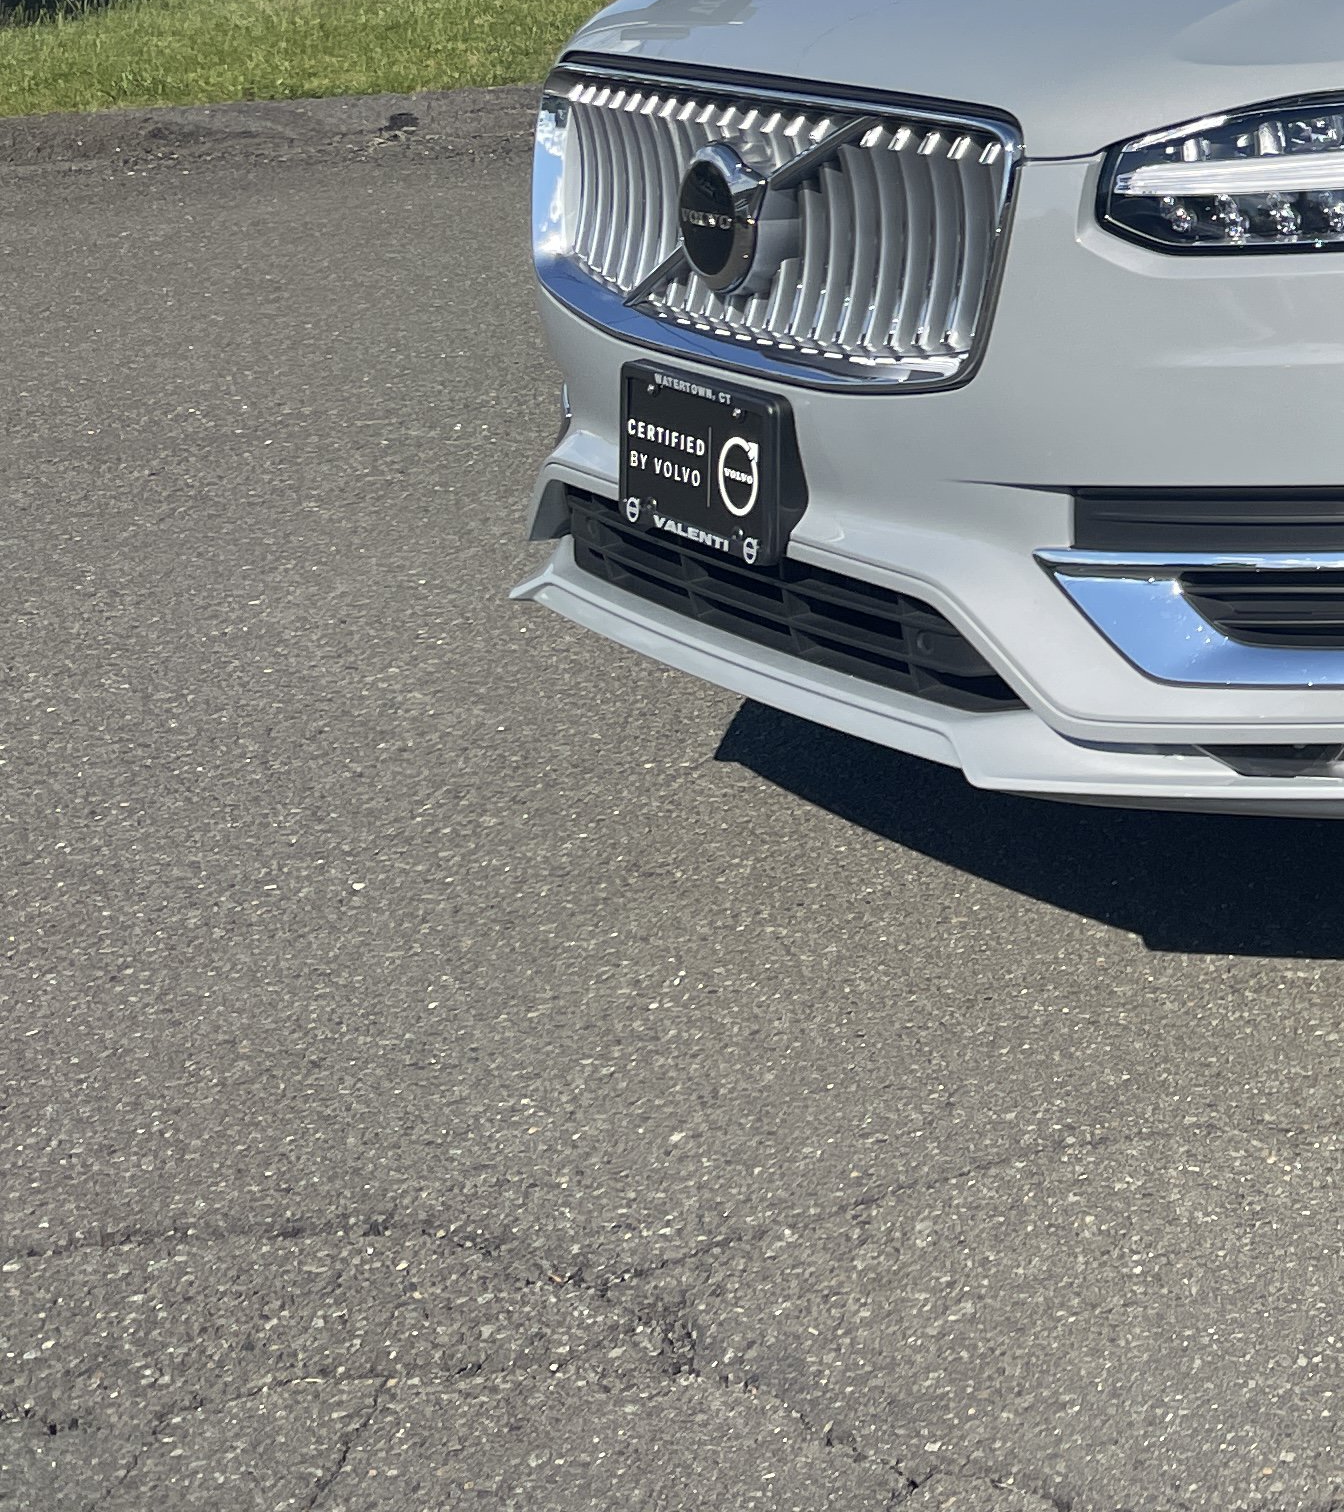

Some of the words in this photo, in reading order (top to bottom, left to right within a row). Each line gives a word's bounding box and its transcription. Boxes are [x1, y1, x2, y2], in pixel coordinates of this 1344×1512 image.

[681, 207, 733, 230] VOLVO
[654, 373, 715, 401] WATERTOWN,
[718, 392, 731, 405] CT
[627, 418, 705, 456] CERTIFIED
[630, 450, 648, 470] BY
[654, 457, 701, 487] VOLVO
[724, 467, 754, 485] VOLVO
[653, 514, 730, 552] VALENTI
